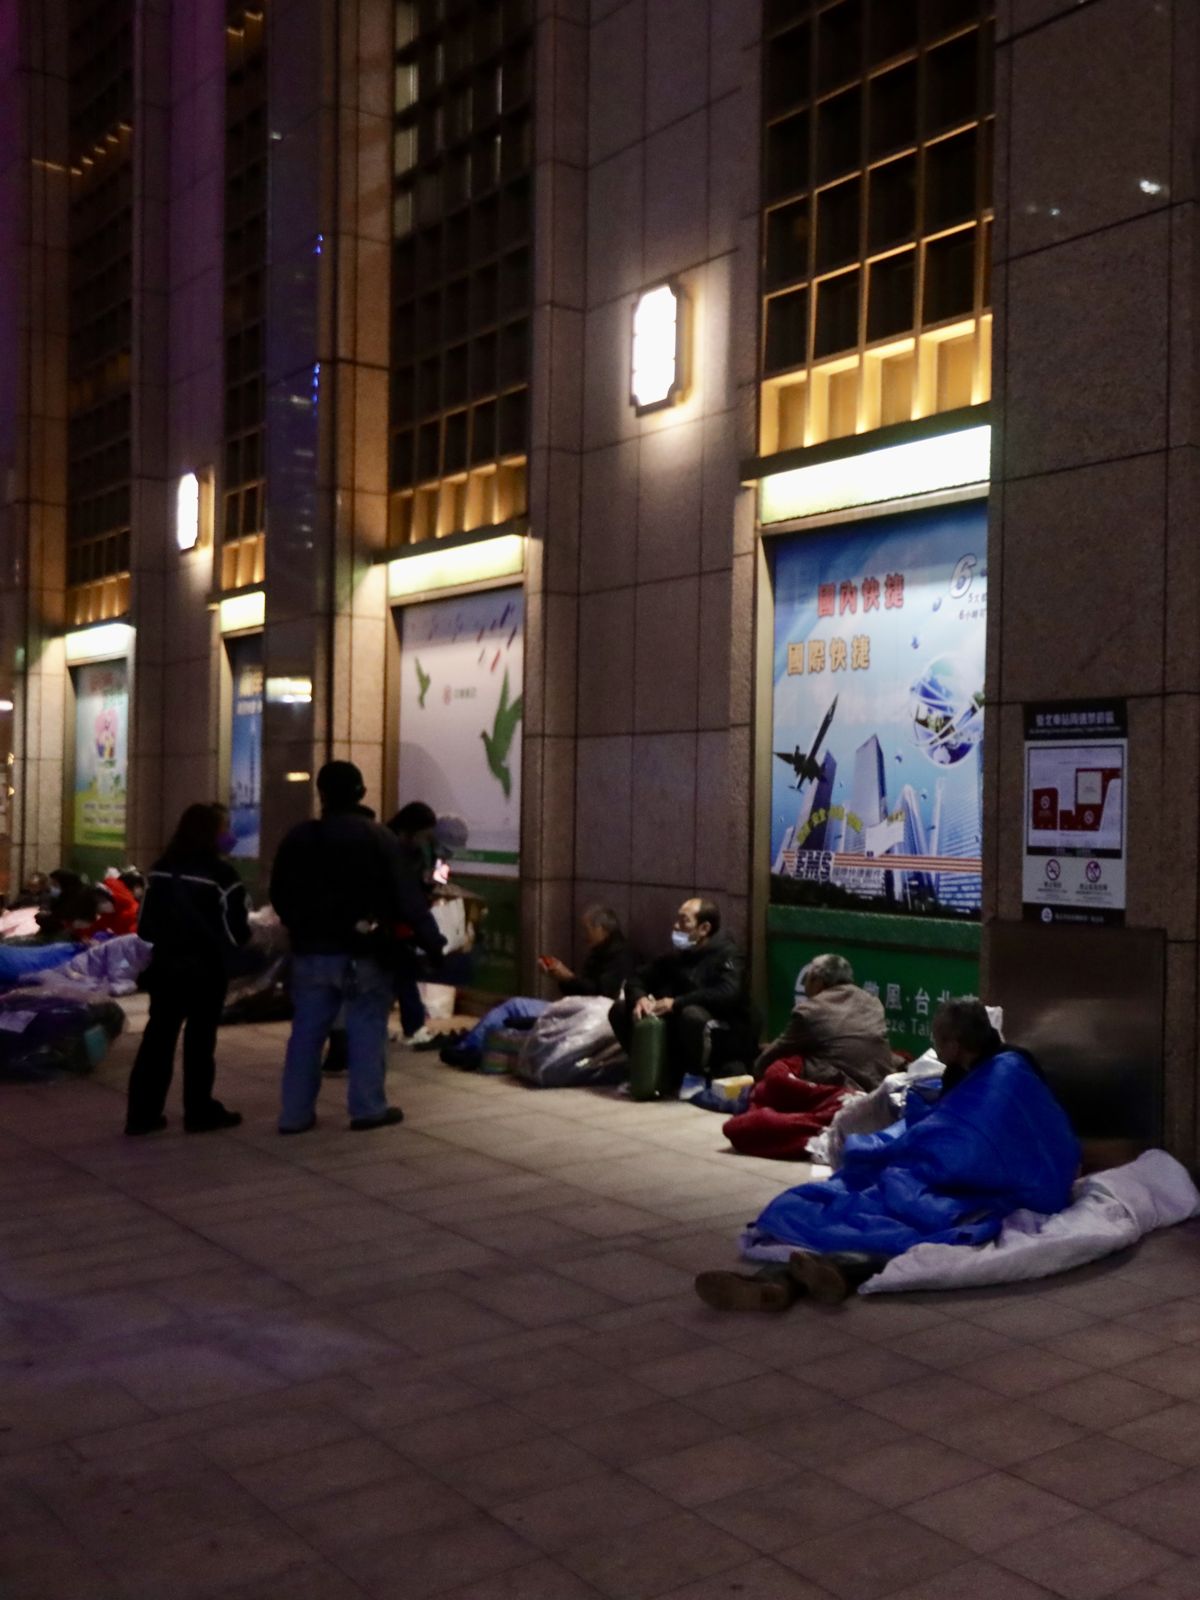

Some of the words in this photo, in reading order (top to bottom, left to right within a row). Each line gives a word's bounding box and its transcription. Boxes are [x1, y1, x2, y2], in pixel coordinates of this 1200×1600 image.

[819, 573, 904, 617] 國內快捷
[950, 552, 977, 599] 6
[788, 635, 870, 675] 國際快捷
